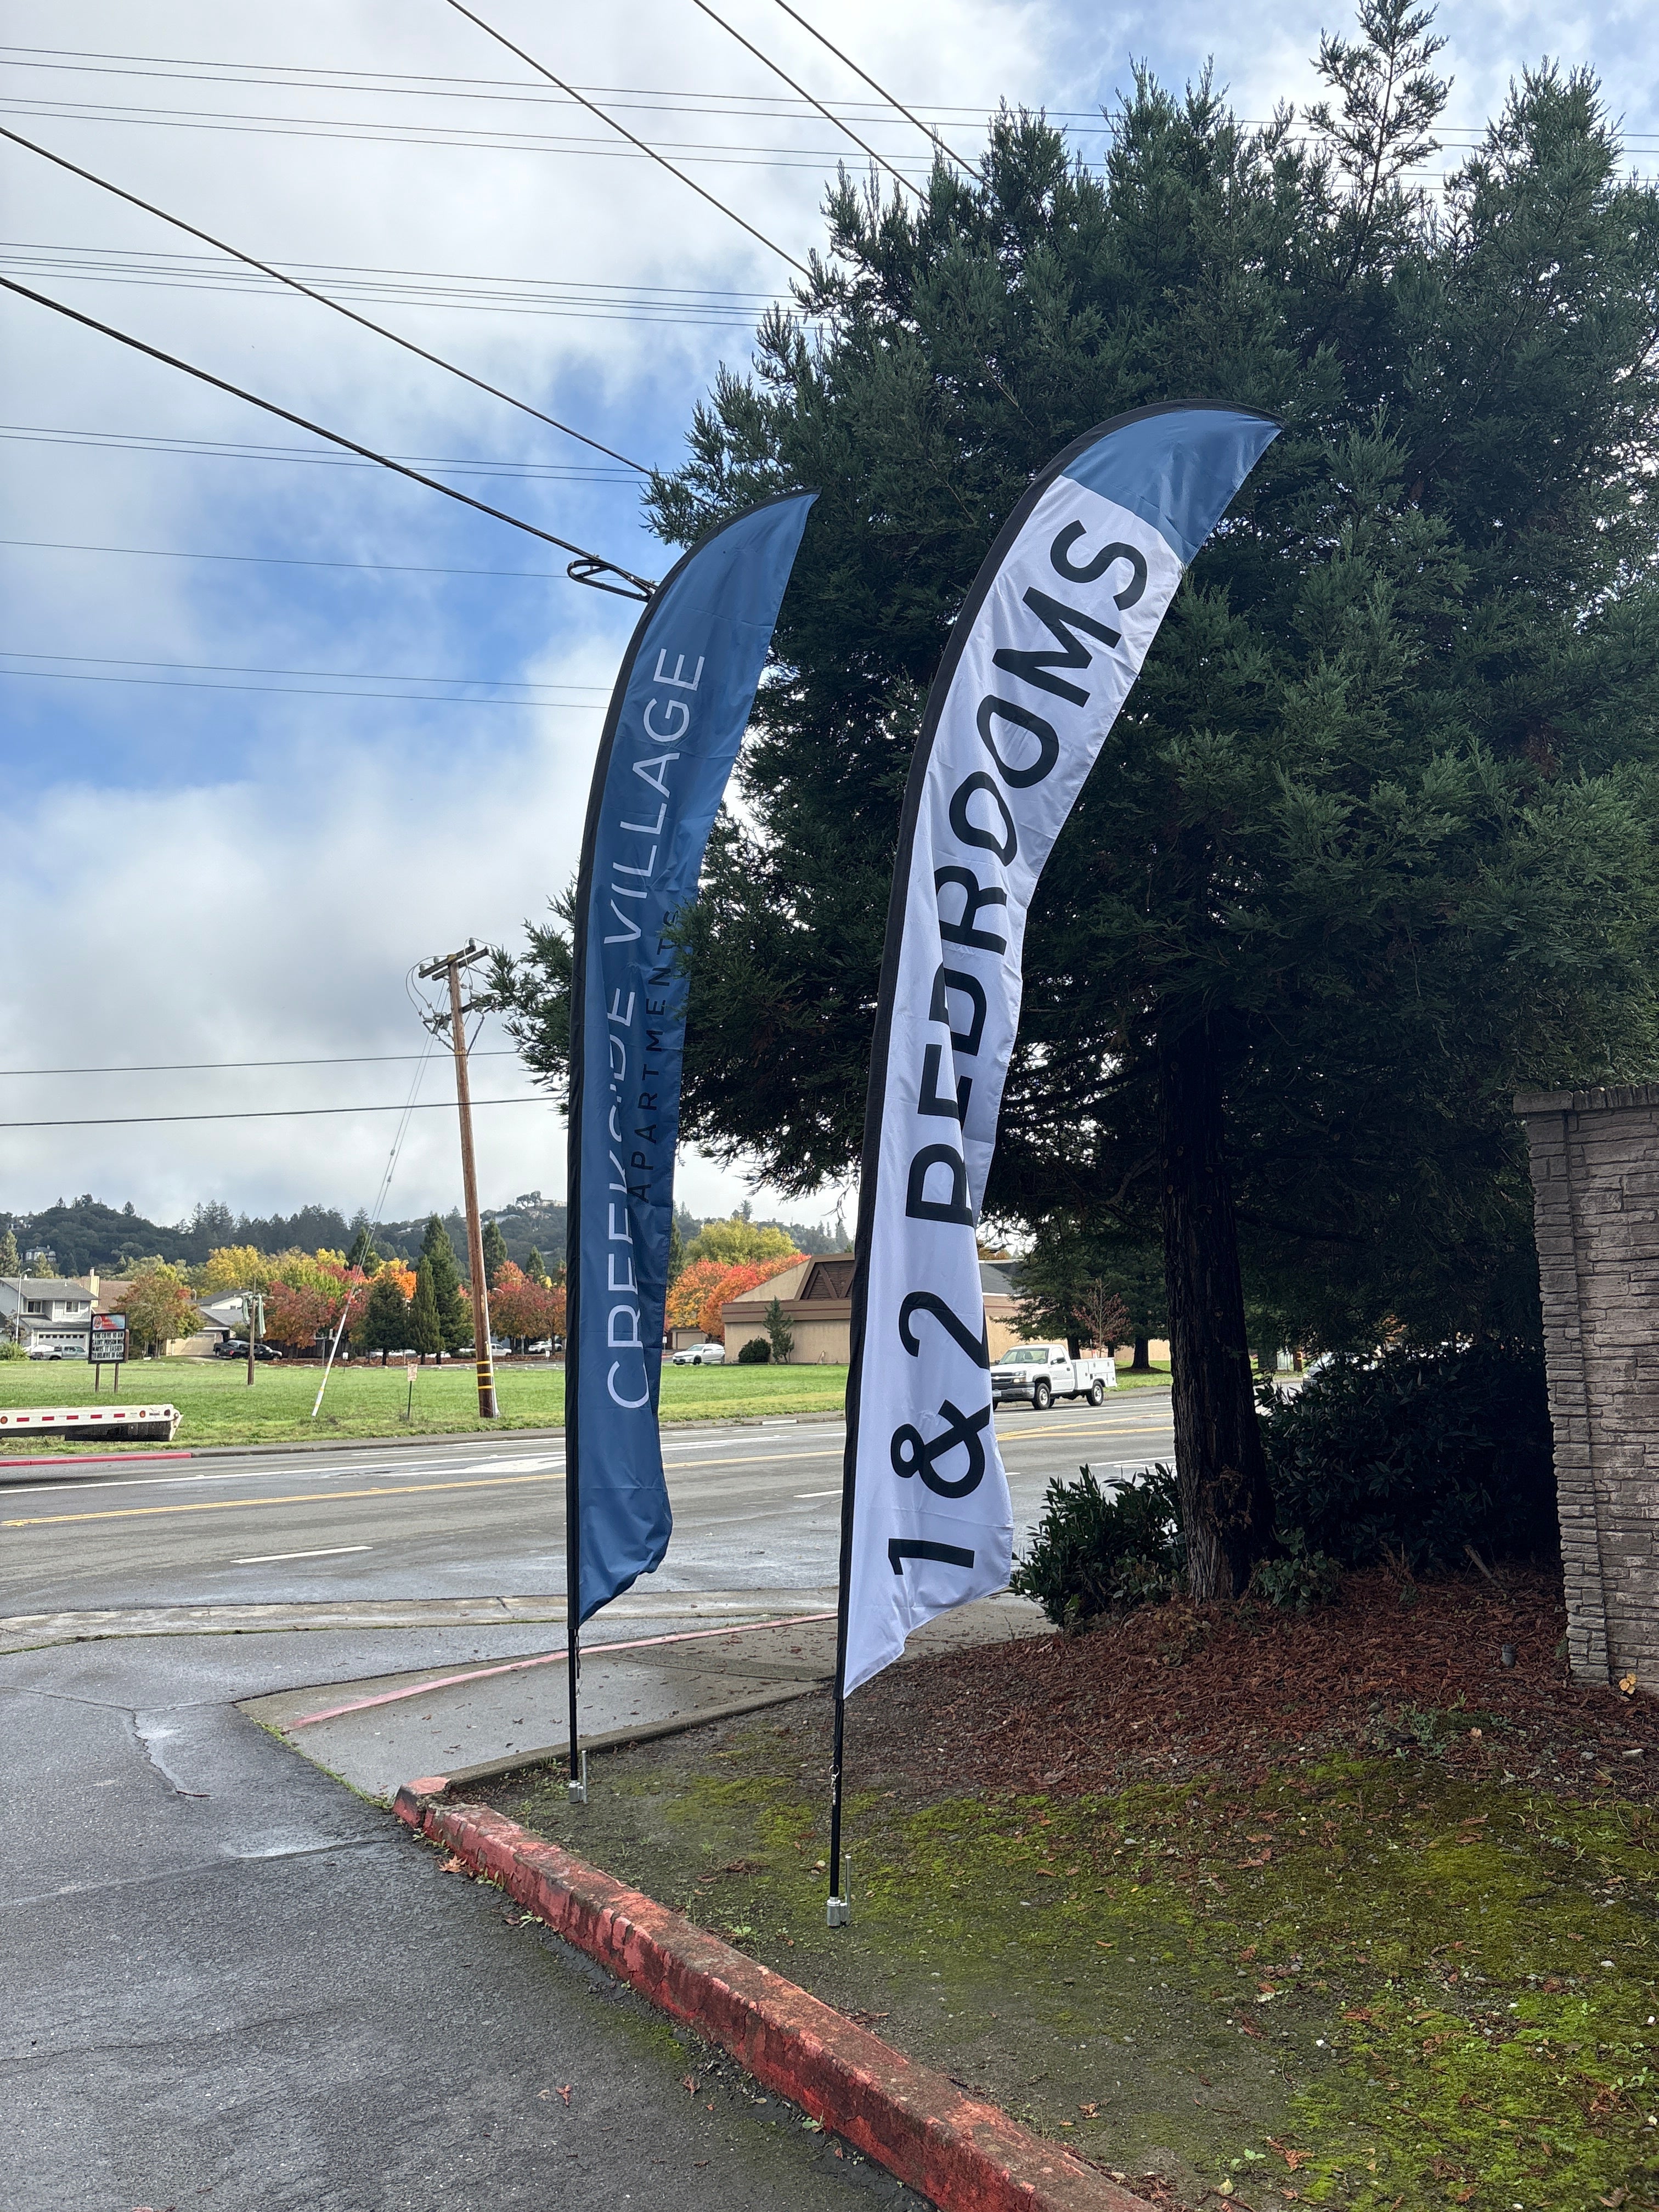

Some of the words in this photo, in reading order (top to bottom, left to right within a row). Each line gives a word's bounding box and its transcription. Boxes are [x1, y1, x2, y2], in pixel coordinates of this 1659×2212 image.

[604, 648, 705, 944] VILLAGE
[628, 910, 678, 1203] APARTMENTS
[890, 1400, 991, 1499] &
